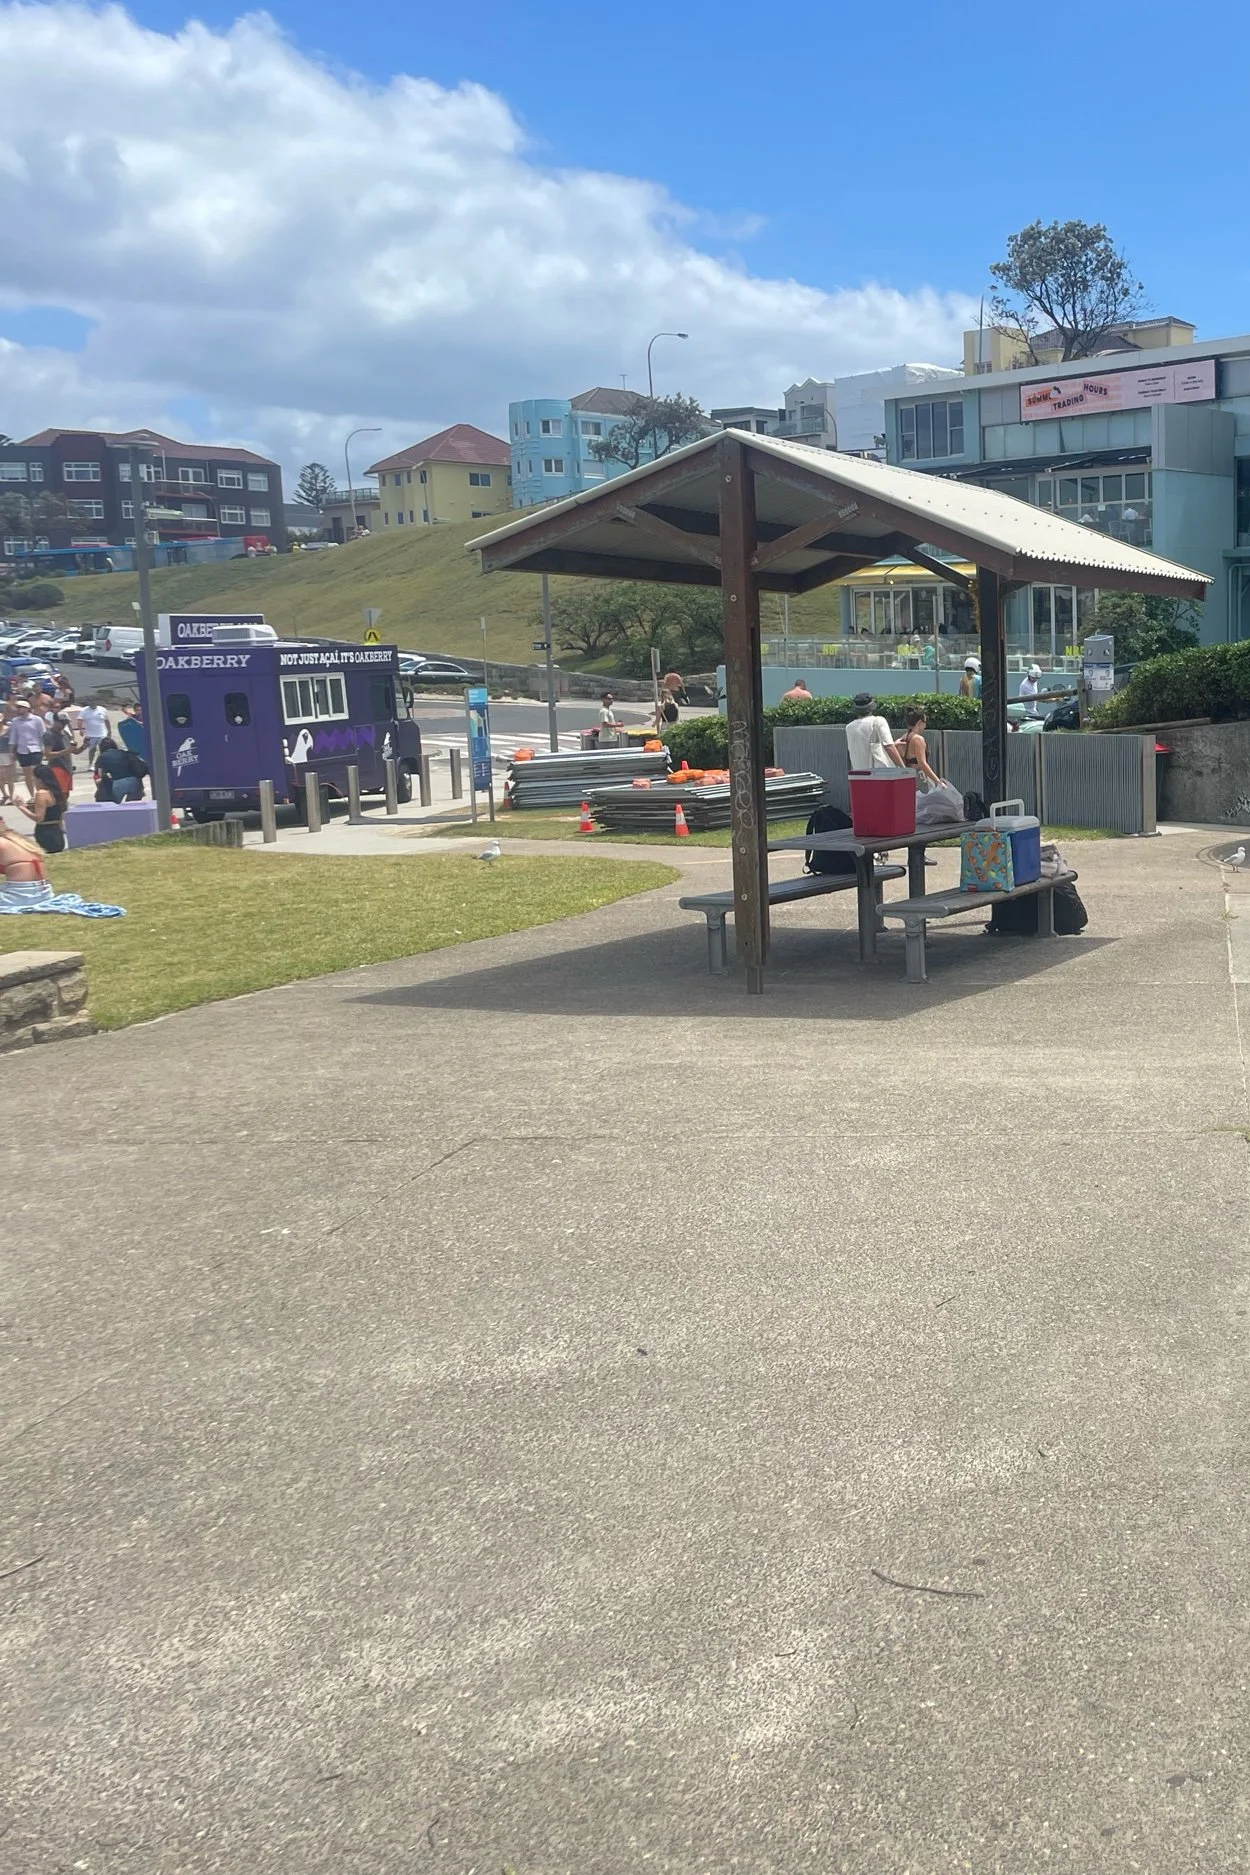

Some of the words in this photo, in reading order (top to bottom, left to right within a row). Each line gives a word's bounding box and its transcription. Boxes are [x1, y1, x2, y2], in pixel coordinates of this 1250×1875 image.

[1083, 383, 1108, 396] HOURS
[1027, 392, 1052, 405] SUMM
[1053, 395, 1084, 410] TRADING
[178, 622, 234, 638] OAKBE
[157, 655, 251, 670] OAKBERRY
[280, 653, 298, 666] NOT
[299, 652, 319, 665] JUST
[340, 651, 354, 663] IT'S
[355, 650, 393, 663] OAKBERRY
[172, 754, 199, 767] BERRY
[176, 750, 193, 760] OAK
